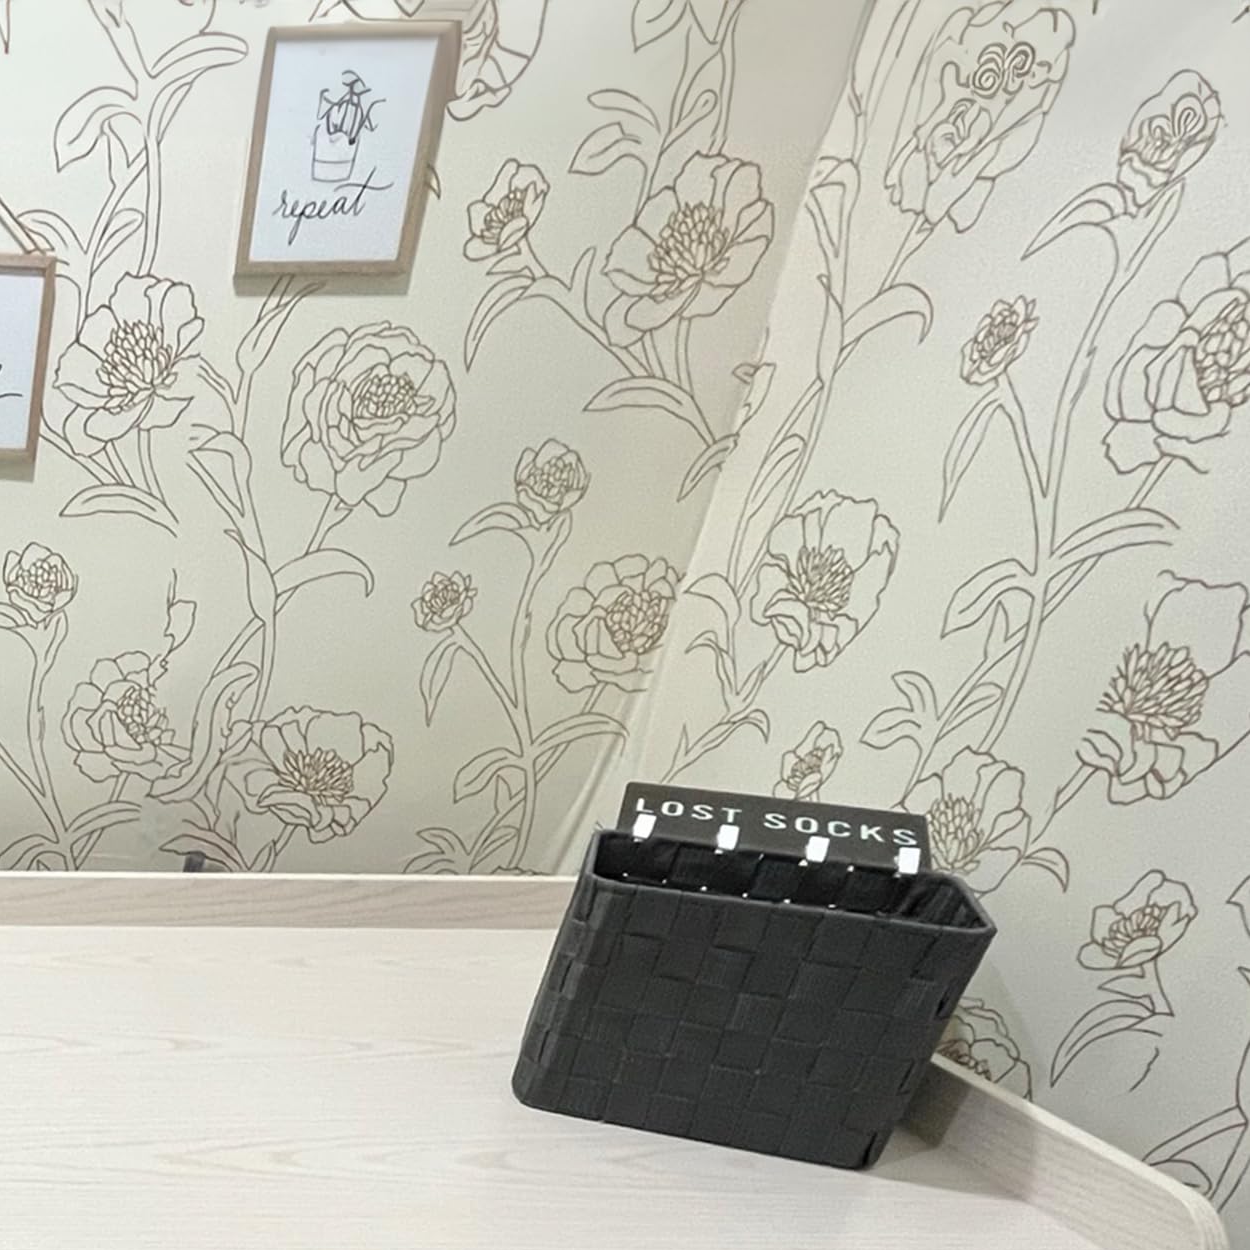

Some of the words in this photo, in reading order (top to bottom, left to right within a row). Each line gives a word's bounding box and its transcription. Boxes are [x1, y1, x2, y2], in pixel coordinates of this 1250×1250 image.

[271, 165, 395, 246] repeat
[635, 797, 742, 824] LOST
[763, 812, 918, 846] SOCKS
